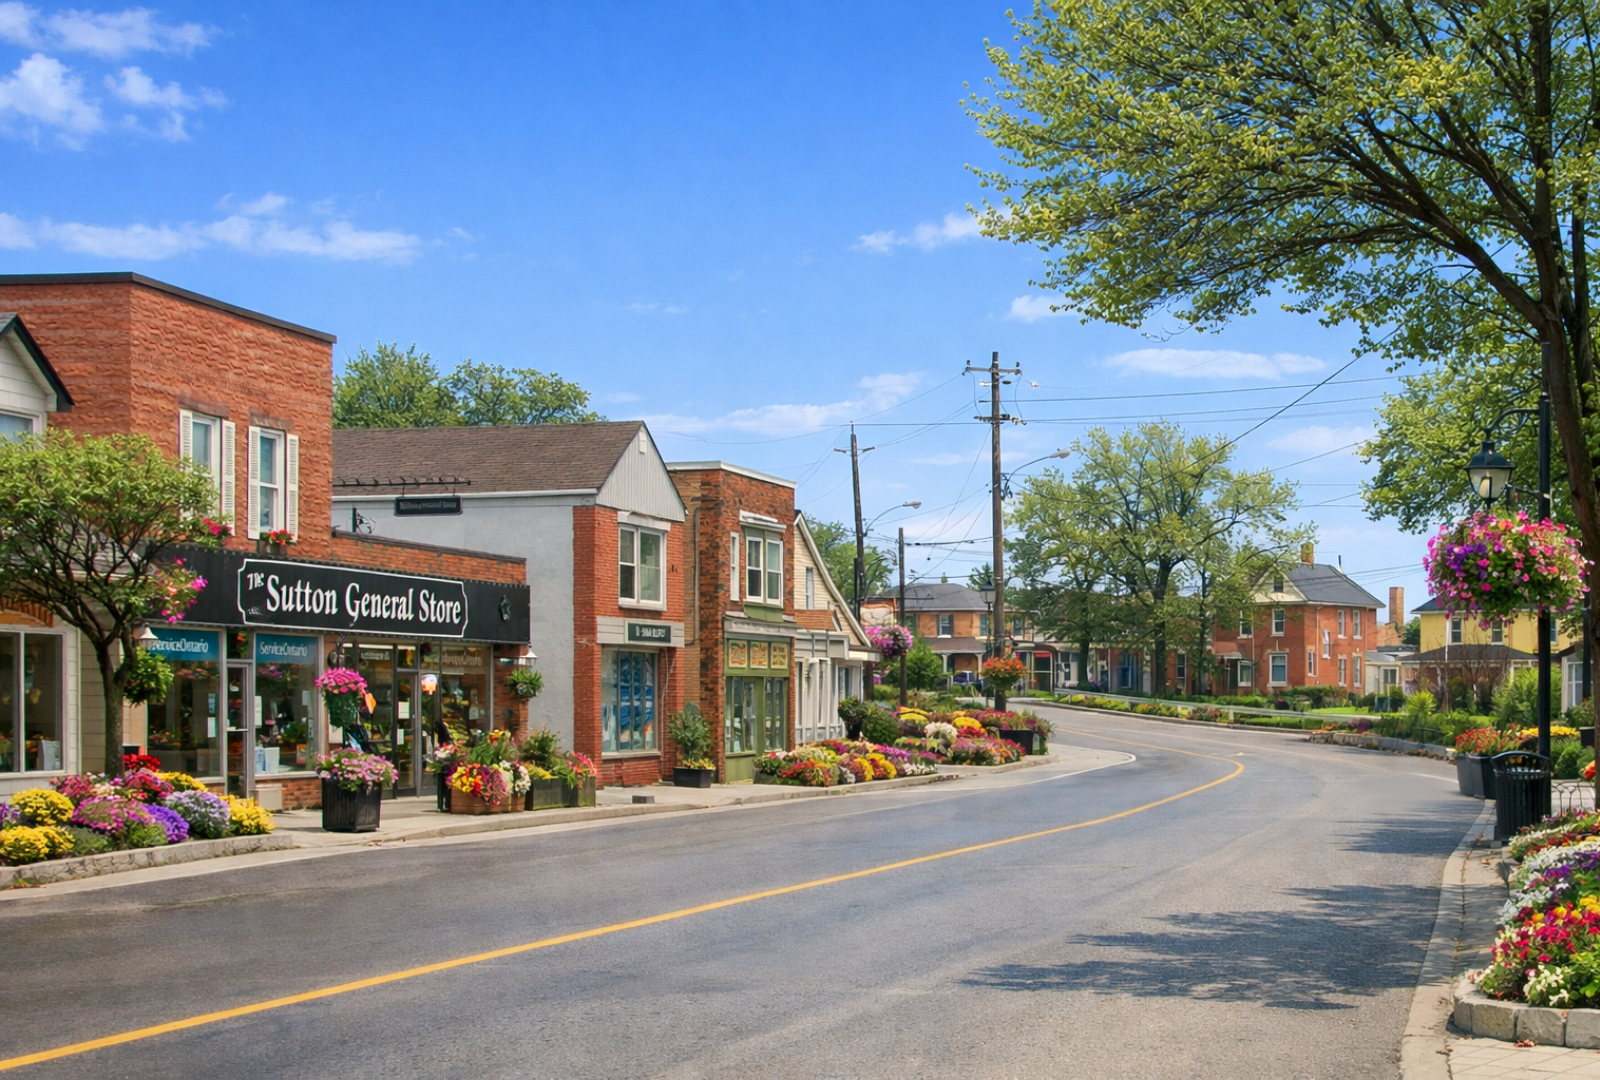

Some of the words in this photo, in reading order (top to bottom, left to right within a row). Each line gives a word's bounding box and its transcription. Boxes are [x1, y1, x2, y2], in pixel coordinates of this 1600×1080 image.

[266, 574, 338, 615] Sutton
[345, 582, 414, 627] General
[419, 589, 461, 624] Store
